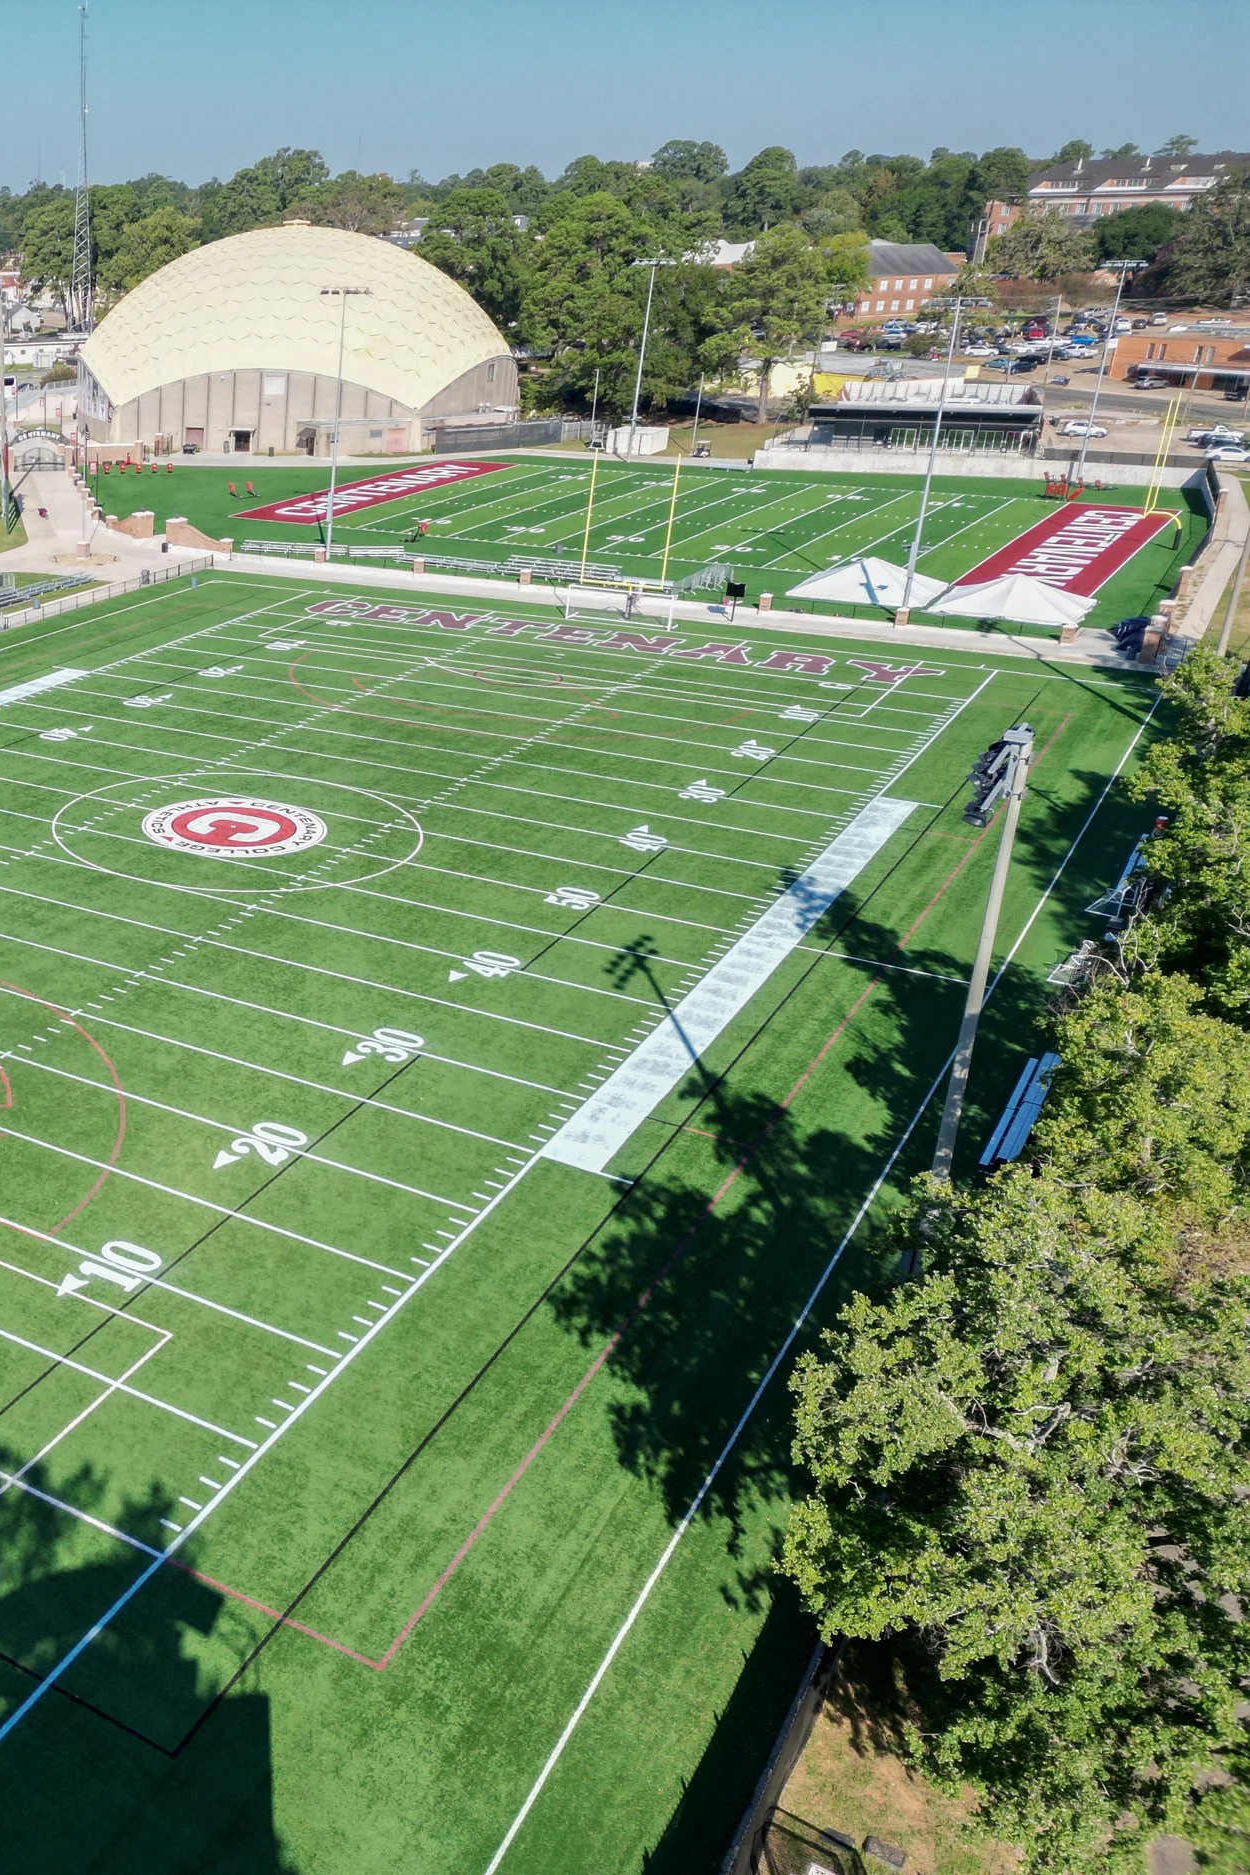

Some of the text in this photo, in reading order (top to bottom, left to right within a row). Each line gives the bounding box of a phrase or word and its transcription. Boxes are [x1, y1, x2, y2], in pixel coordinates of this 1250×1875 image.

[18, 430, 60, 441] CENTENARY
[275, 464, 480, 516] CENTENARY
[305, 600, 946, 684] CENTENARY
[197, 666, 236, 677] 20
[123, 695, 162, 708] 30
[778, 707, 820, 722] 10
[39, 728, 78, 742] 40
[731, 744, 776, 761] 20
[678, 785, 726, 803] 30
[151, 801, 218, 834] ATHLETICS
[251, 802, 317, 846] CENTENARY
[175, 841, 286, 855] COLLEGE
[619, 832, 668, 851] 40
[543, 887, 600, 910] 50
[462, 951, 521, 978] 40
[356, 1028, 425, 1062] 30
[231, 1122, 308, 1166] 20
[78, 1240, 162, 1292] 10
